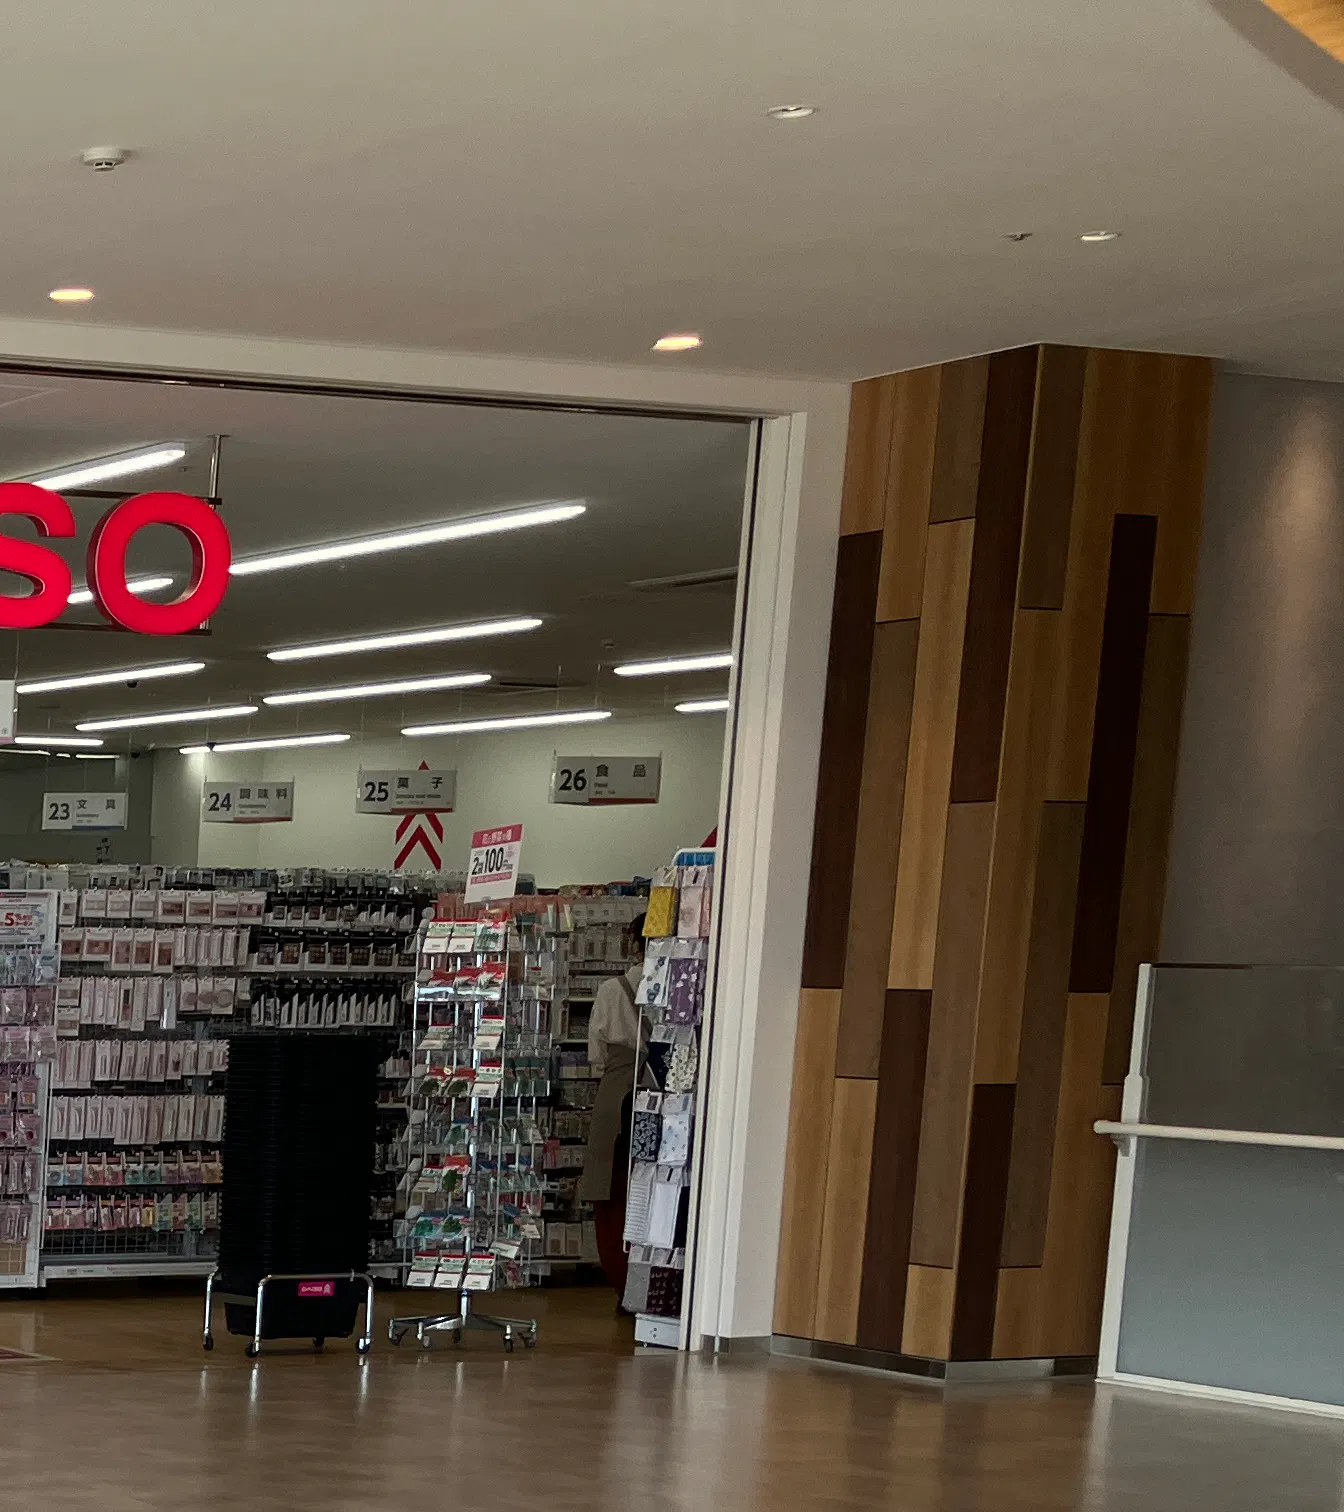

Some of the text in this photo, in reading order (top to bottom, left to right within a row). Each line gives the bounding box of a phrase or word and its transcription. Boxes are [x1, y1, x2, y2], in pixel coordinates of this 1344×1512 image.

[558, 763, 647, 791] 26 食品
[364, 781, 389, 802] 25
[397, 776, 444, 790] 菓子
[48, 802, 70, 821] 23
[208, 792, 232, 812] 24
